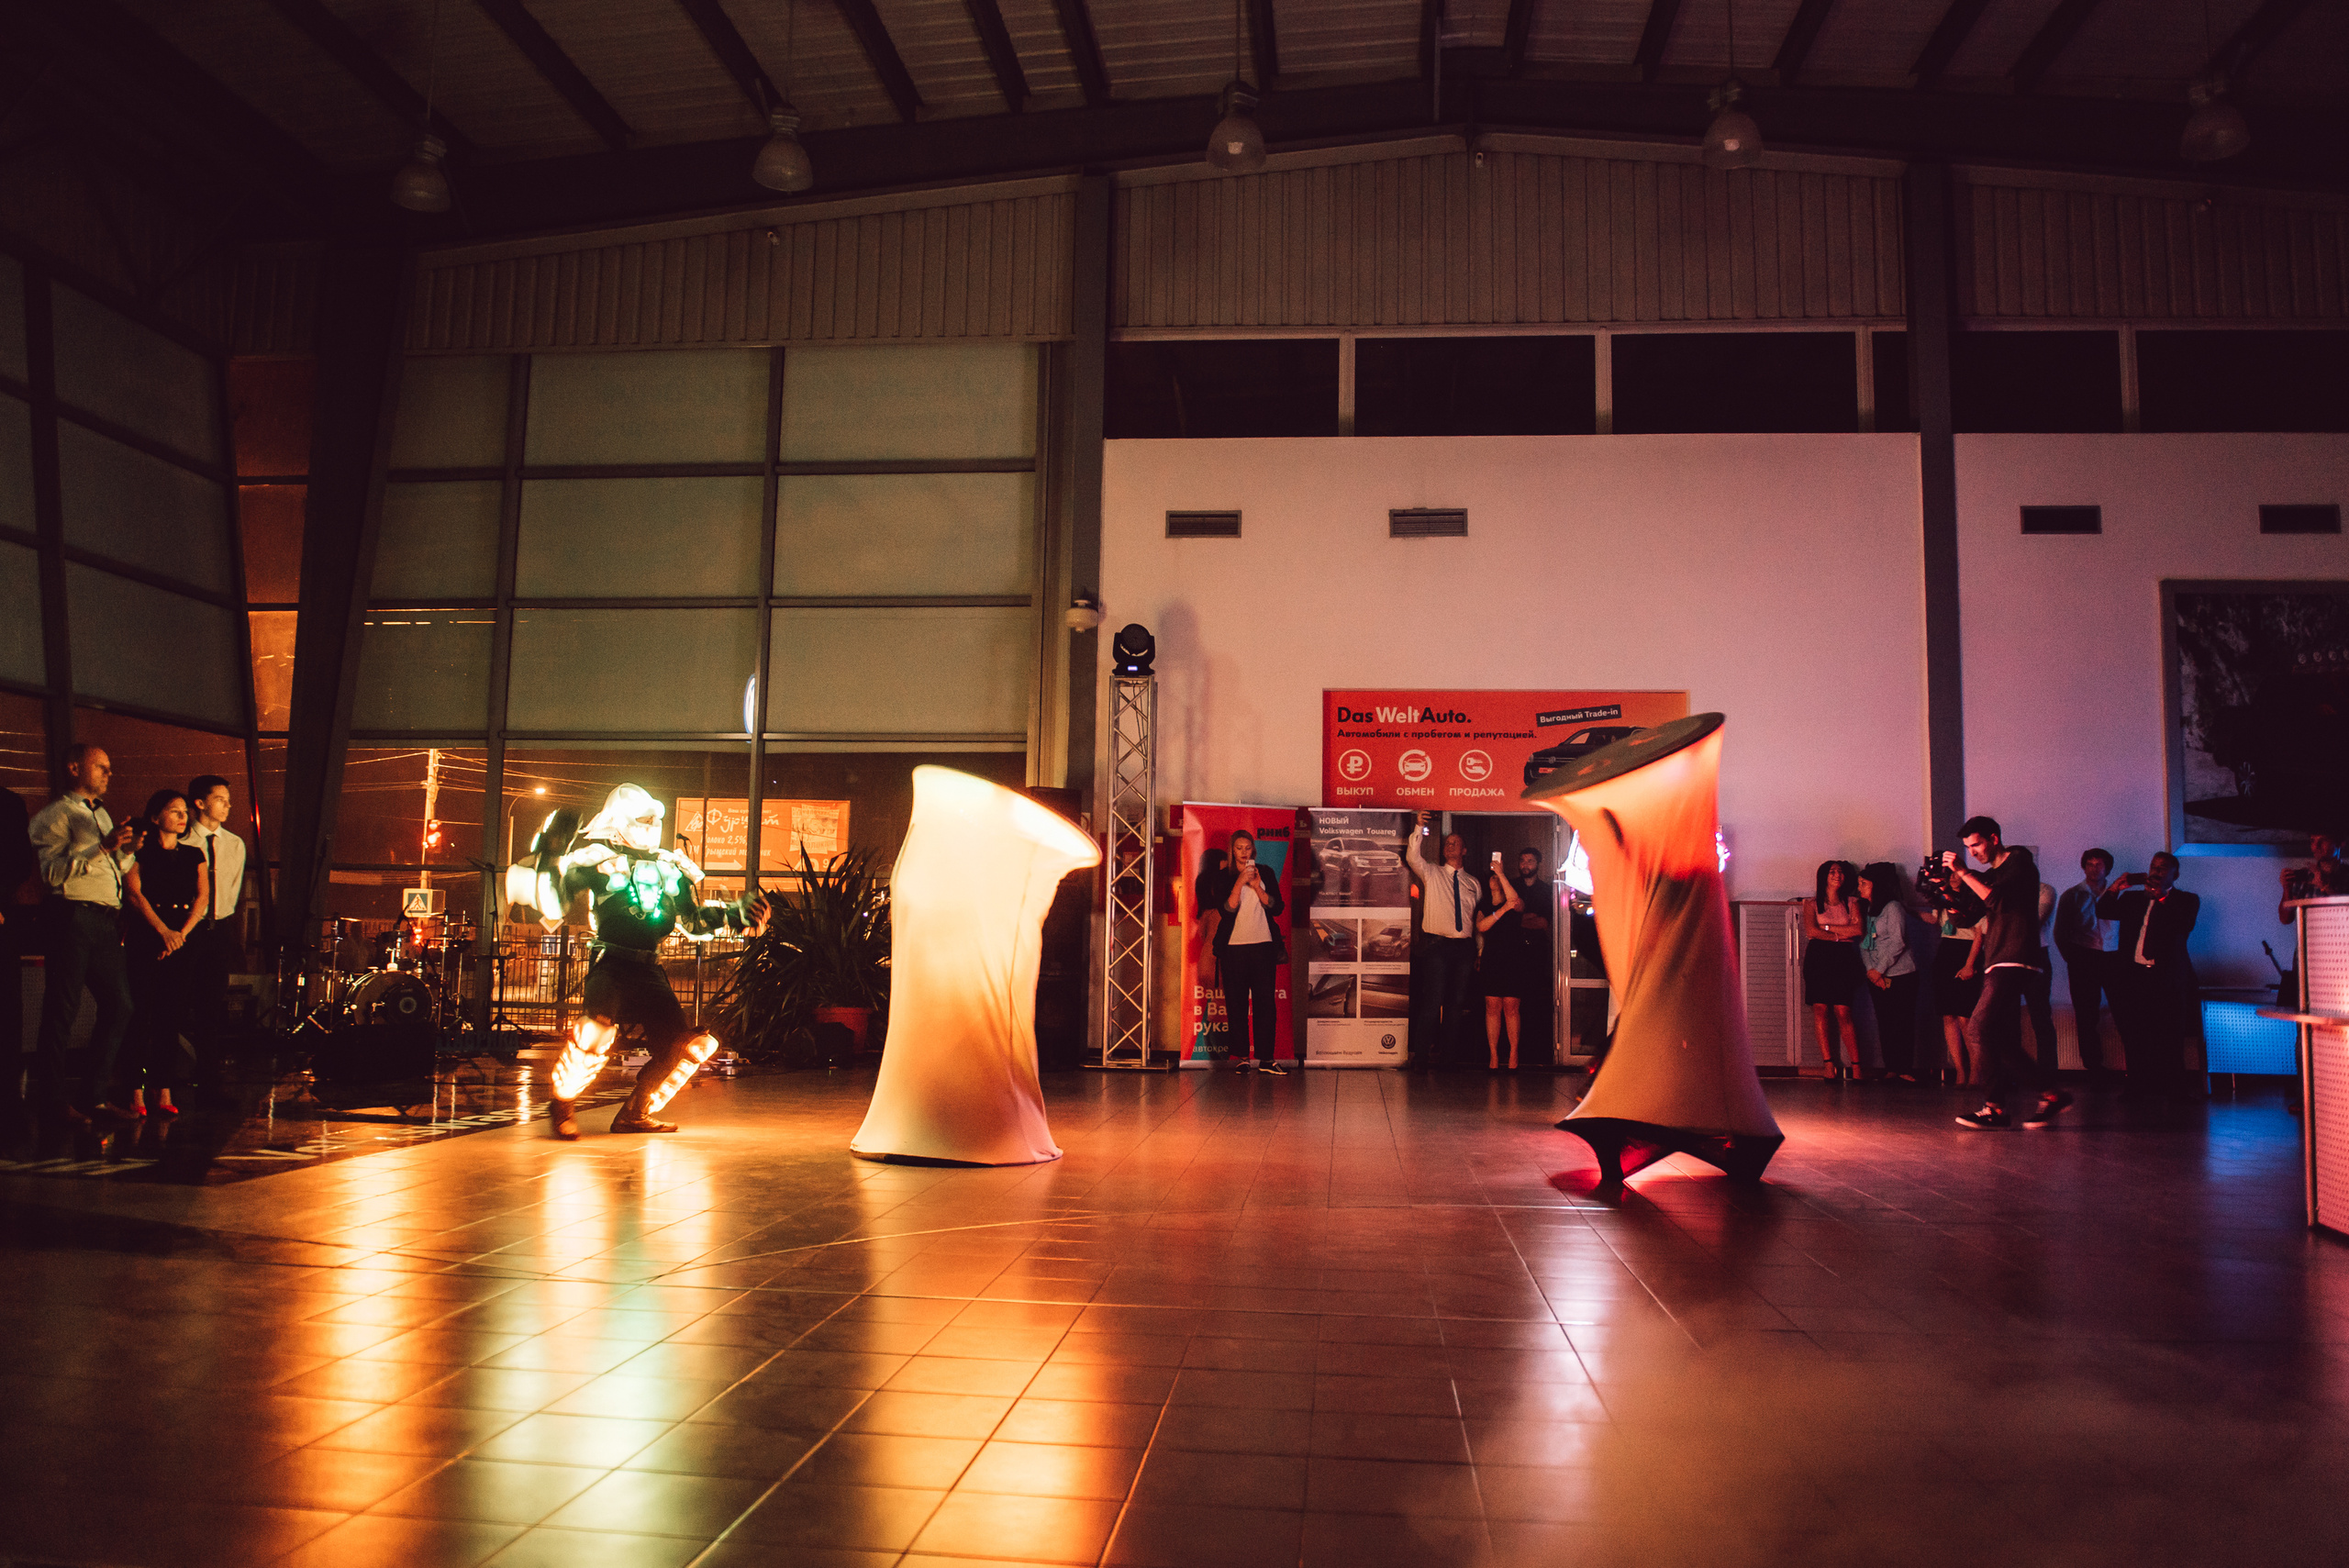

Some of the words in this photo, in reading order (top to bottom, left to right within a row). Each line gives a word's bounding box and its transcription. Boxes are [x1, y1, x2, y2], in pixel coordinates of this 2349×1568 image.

[1337, 706, 1374, 724] Das
[1540, 712, 1584, 723] Выгодный
[1585, 708, 1619, 718] Trade-in
[1337, 728, 1401, 739] Автомобили
[1411, 729, 1462, 740] пробегом
[1474, 728, 1538, 740] репутацией.
[1336, 787, 1375, 796] ВЫКУП
[1397, 787, 1435, 796] ОБМЕН
[1449, 787, 1505, 797] ПРОДАЖА
[1319, 816, 1350, 825] НОВЫЙ
[1319, 827, 1364, 837] Volkswagen
[1367, 828, 1397, 837] Touareg
